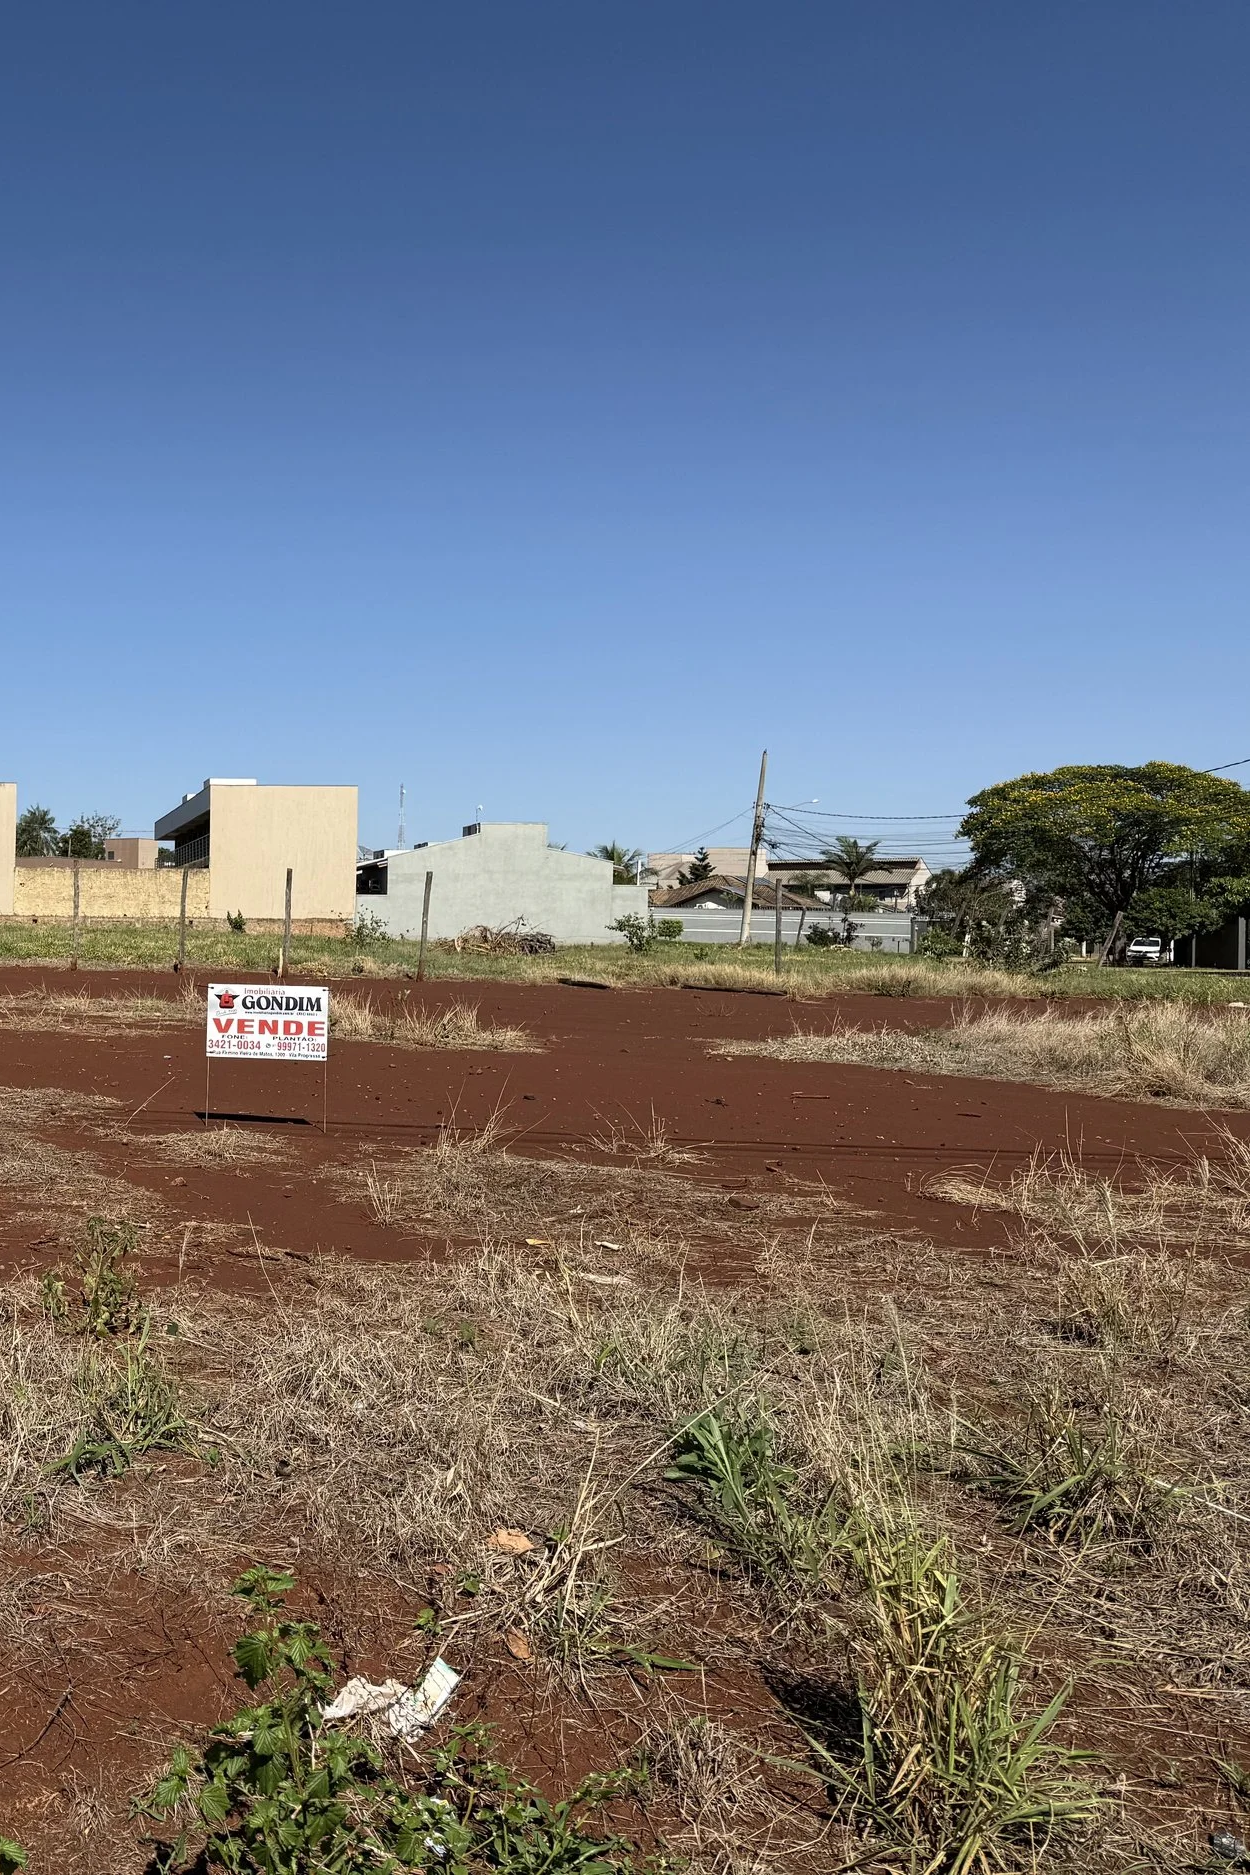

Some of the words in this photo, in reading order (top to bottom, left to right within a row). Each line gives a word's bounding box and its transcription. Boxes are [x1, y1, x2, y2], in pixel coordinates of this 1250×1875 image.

[241, 995, 322, 1012] GONDIM
[212, 1017, 325, 1037] VENDE
[208, 1039, 261, 1050] 3421-0034
[277, 1041, 326, 1053] 99971-1320
